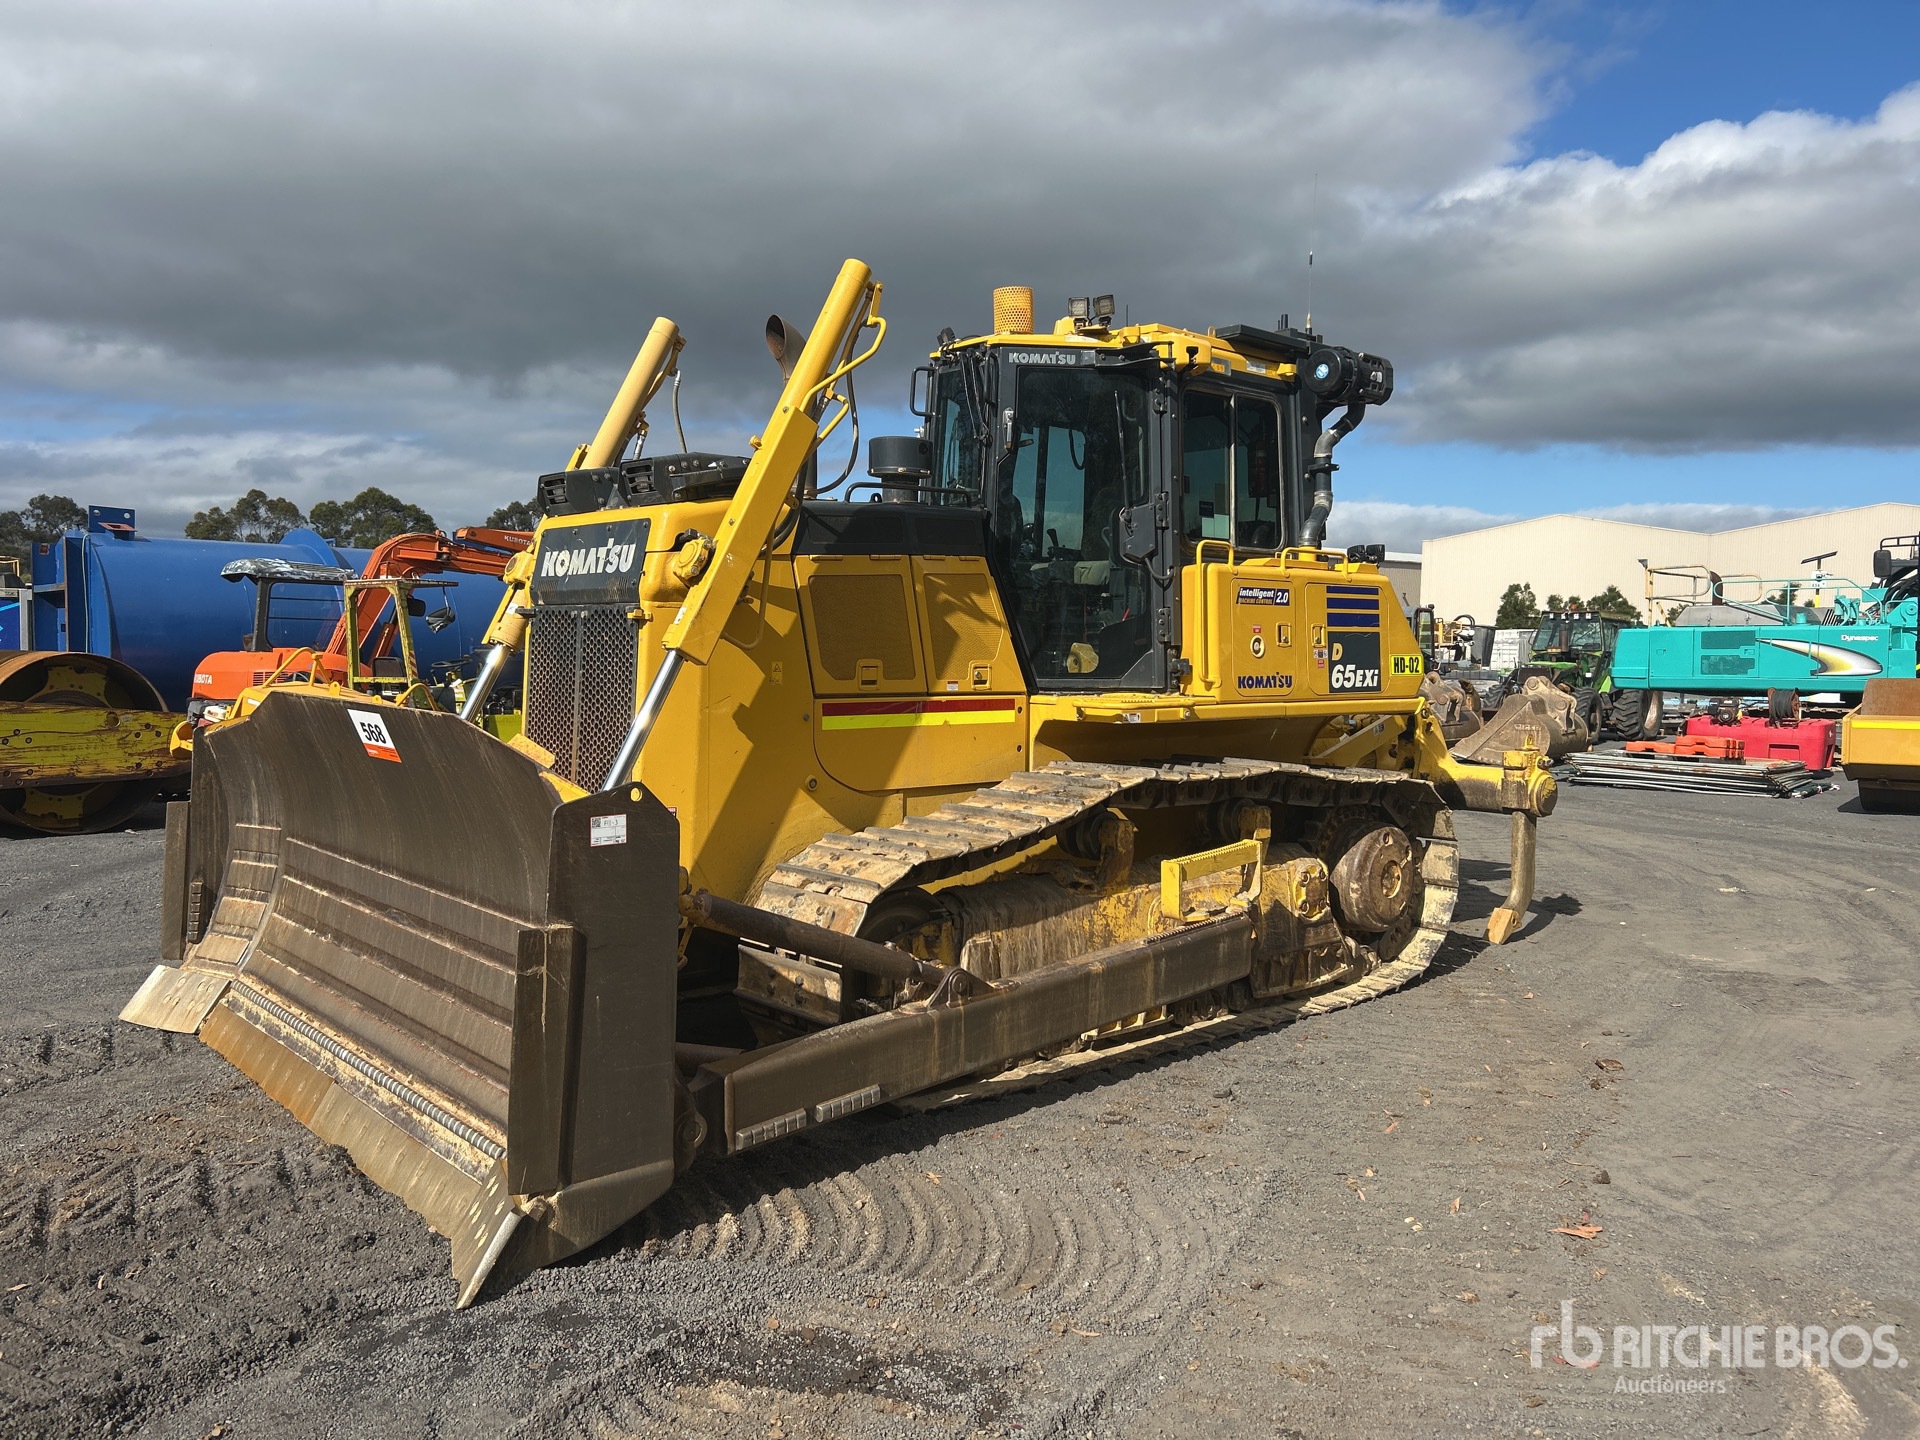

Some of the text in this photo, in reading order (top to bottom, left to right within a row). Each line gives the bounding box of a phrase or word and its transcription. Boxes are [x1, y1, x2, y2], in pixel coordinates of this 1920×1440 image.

[1008, 351, 1076, 365] KOMATSU
[541, 538, 637, 577] KOMATSU
[1239, 587, 1289, 604] intelligent 2.0
[1331, 642, 1344, 661] D
[1393, 656, 1420, 674] HD-02
[1237, 672, 1293, 689] KOMATSU
[1331, 663, 1379, 690] 65EXi
[359, 721, 387, 744] 568
